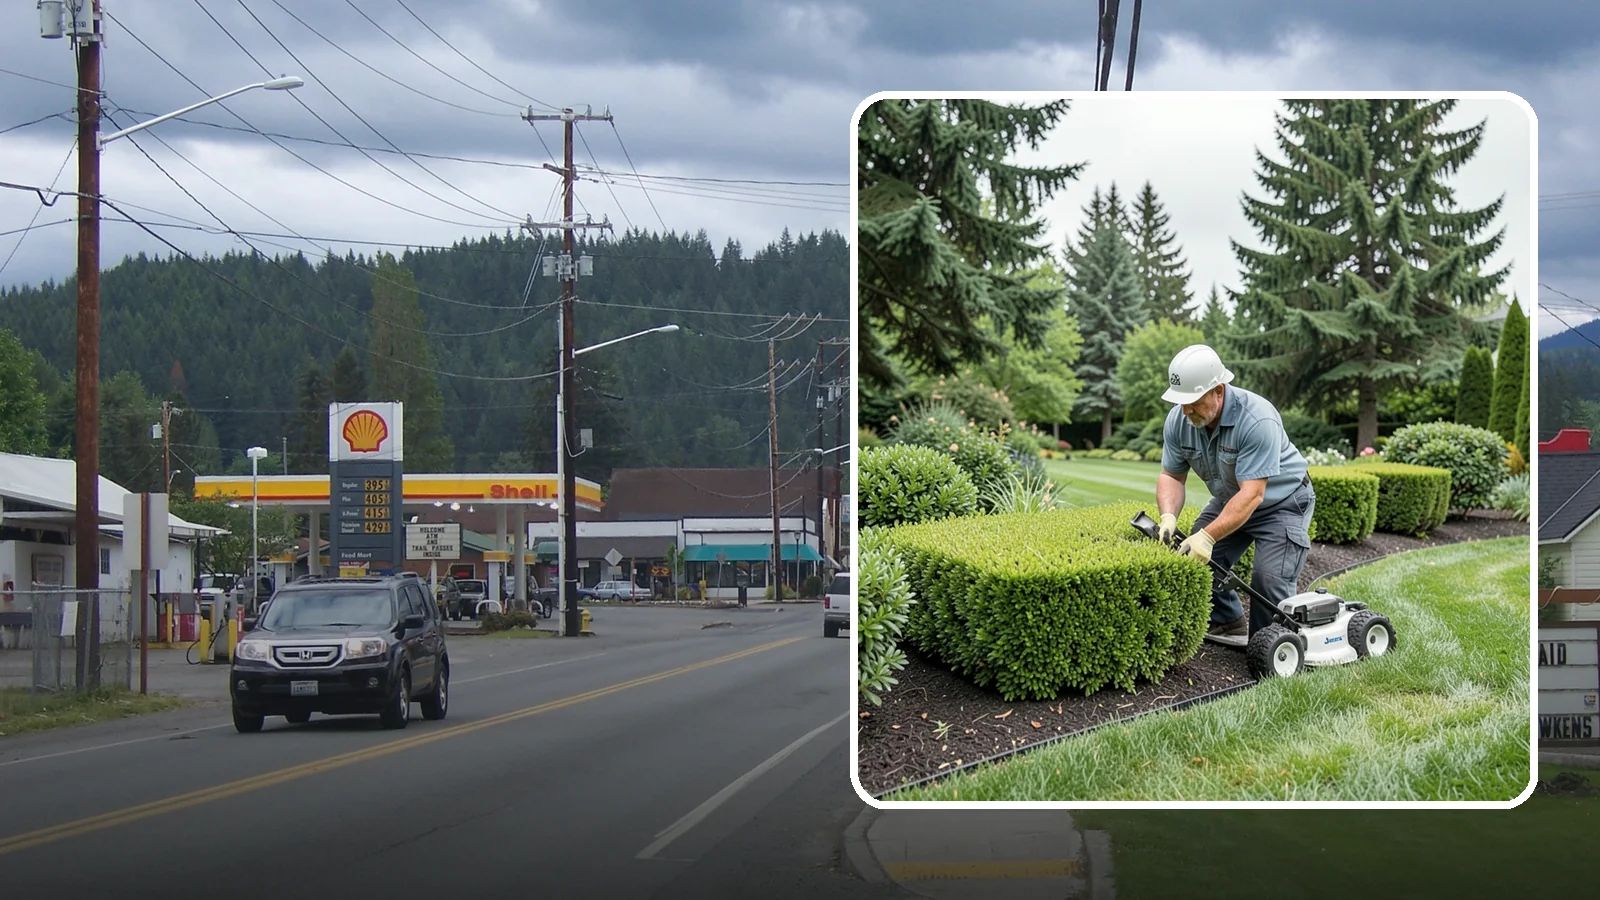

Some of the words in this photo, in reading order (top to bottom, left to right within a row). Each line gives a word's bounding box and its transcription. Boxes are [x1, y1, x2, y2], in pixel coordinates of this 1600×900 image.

[366, 480, 383, 490] 395
[490, 484, 547, 499] Shell
[366, 494, 383, 504] 405
[366, 508, 383, 518] 415
[366, 522, 383, 532] 429
